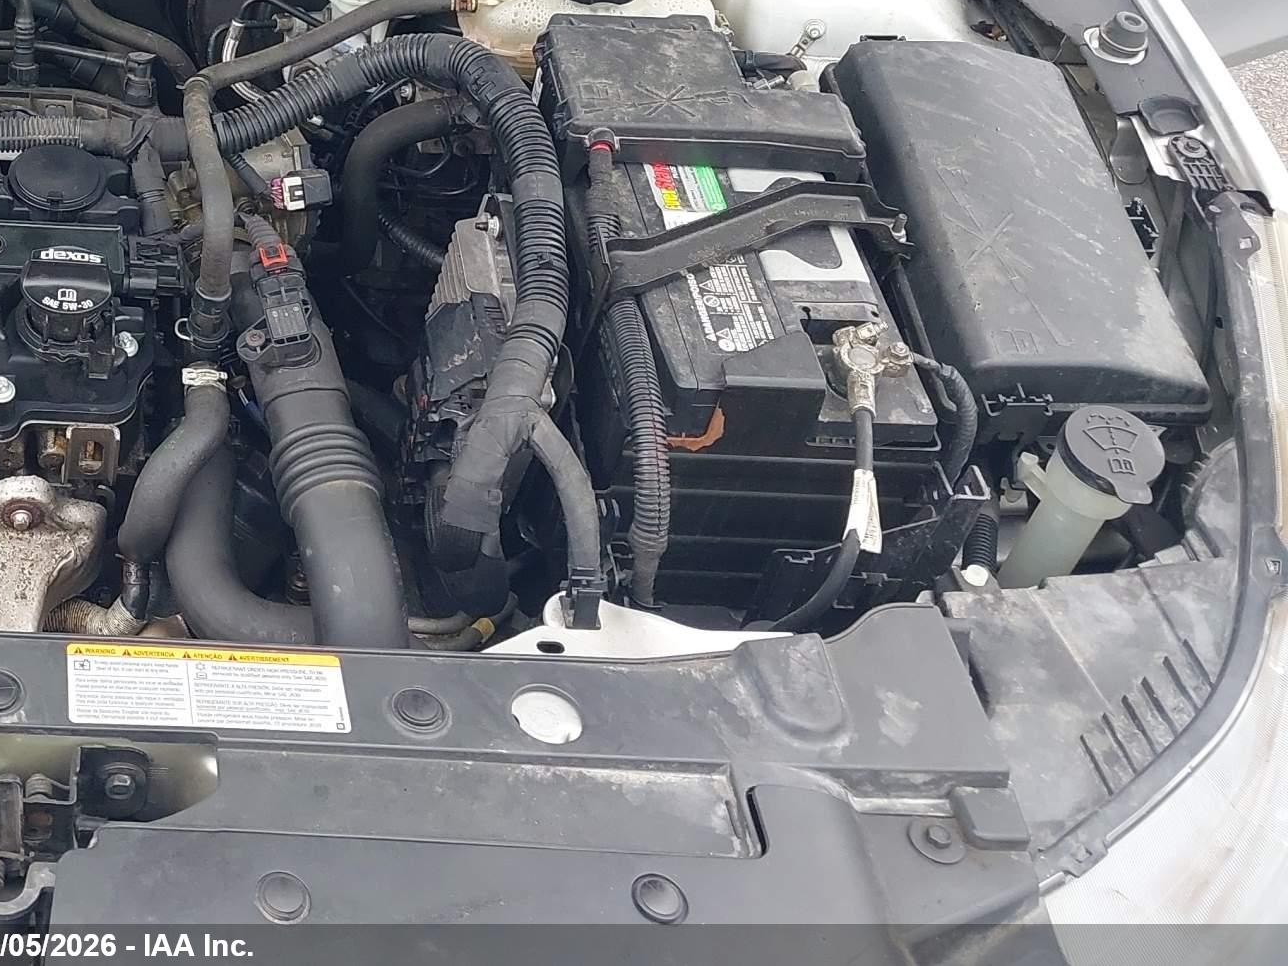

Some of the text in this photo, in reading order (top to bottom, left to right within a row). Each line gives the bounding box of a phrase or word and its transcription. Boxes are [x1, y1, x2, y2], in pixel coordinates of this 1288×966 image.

[40, 248, 104, 263] dexos
[42, 296, 94, 311] SAE 5W-30
[687, 273, 714, 334] DANGER/POISO
[85, 647, 116, 655] WARNING
[134, 649, 175, 657] ADVERTENCIA
